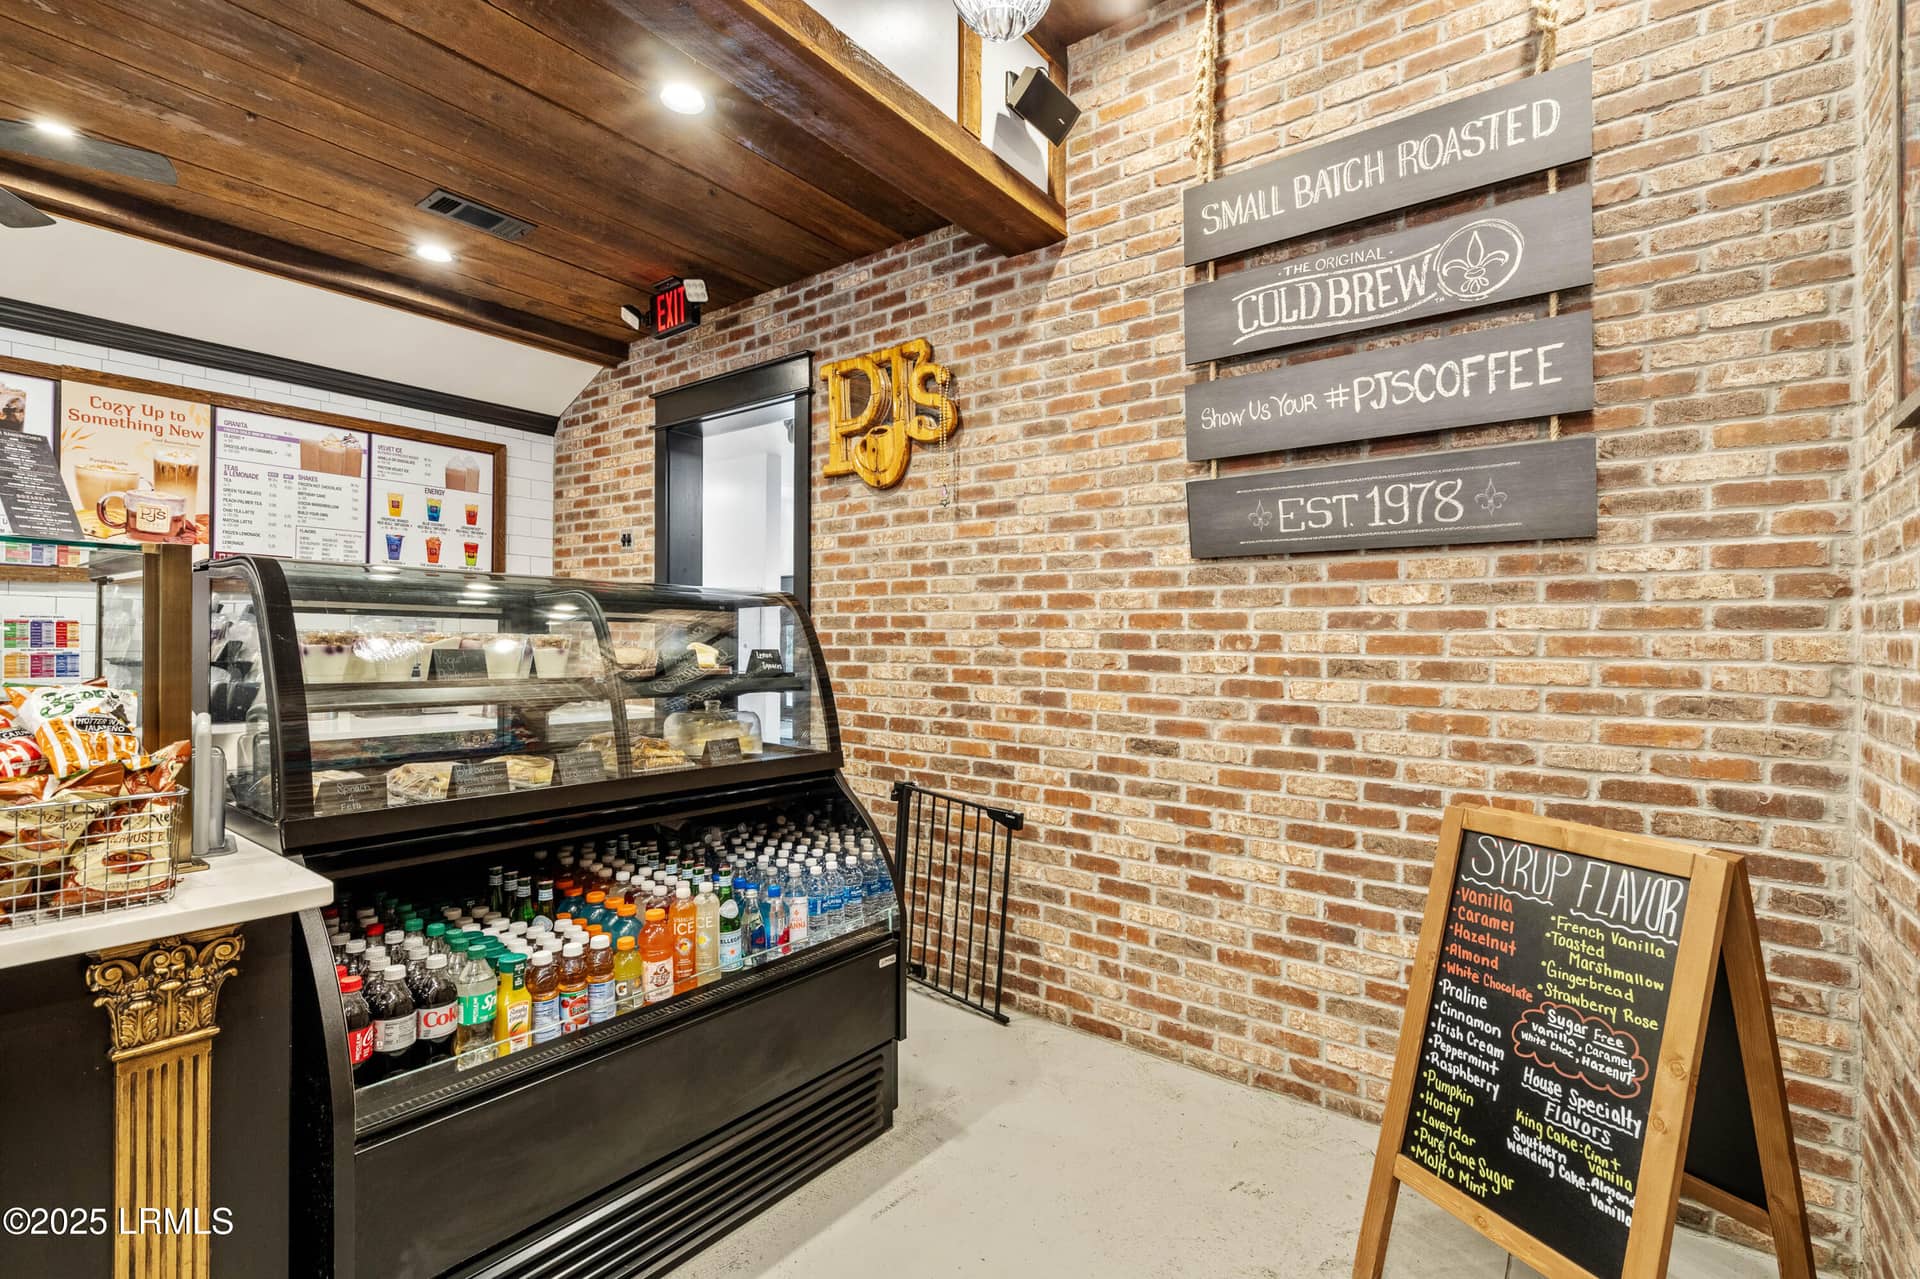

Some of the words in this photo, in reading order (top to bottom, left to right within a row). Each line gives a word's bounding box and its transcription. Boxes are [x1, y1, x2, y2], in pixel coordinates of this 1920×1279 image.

[1201, 184, 1285, 235] SMALL
[1294, 150, 1385, 209] BATCH
[1399, 98, 1561, 177] ROASTED
[1283, 261, 1311, 276] THE
[1315, 247, 1386, 271] ORIGINAL
[656, 285, 685, 332] EXIT
[1201, 407, 1245, 430] Show
[1249, 401, 1271, 420] Us
[1323, 342, 1565, 413] #PJSCOFFEE
[68, 408, 163, 437] Something
[169, 424, 204, 439] New
[141, 404, 164, 421] Up
[170, 410, 186, 422] to
[224, 463, 238, 471] TEAS
[229, 471, 259, 480] LEMONADE
[424, 487, 445, 496] ENERGY
[1367, 478, 1464, 527] 1978
[1471, 836, 1572, 900] SYRUP
[1577, 861, 1684, 937] FLAVOR
[673, 922, 695, 935] ICE
[1458, 906, 1515, 934] Caramel
[1557, 916, 1605, 942] French
[1611, 932, 1665, 958] Vanilla
[1450, 943, 1499, 970] Almond
[1454, 922, 1516, 957] Hazelnut
[1551, 931, 1605, 959] Toasted
[1447, 961, 1480, 983] White
[1483, 974, 1533, 1003] Chocolate
[1547, 960, 1634, 1003] Gingerbread
[1569, 952, 1664, 991] Marshmallow
[1442, 979, 1488, 1009] Praline
[1545, 982, 1617, 1024] Strawberry
[1623, 1008, 1659, 1030] Rose
[422, 1007, 459, 1028] Cok
[1440, 1000, 1501, 1038] Cinnamon
[1548, 1009, 1588, 1035] Sugar
[1594, 1028, 1624, 1048] Free
[1433, 1034, 1500, 1076] Peppermint
[1437, 1017, 1464, 1042] Irish
[1467, 1031, 1505, 1061] Cream
[1521, 1031, 1547, 1047] White
[1426, 1090, 1460, 1124] Honey
[1427, 1069, 1474, 1107] Pumpkin
[1523, 1066, 1563, 1098] House
[1569, 1088, 1642, 1139] Specialty
[1422, 1109, 1476, 1147] Lavendar
[1516, 1108, 1543, 1140] King
[1545, 1101, 1611, 1145] Flavors
[1420, 1127, 1446, 1154] Pure
[1449, 1142, 1476, 1170] Cane
[1479, 1157, 1515, 1195] Sugar
[1507, 1137, 1555, 1178] Wedding
[1512, 1125, 1567, 1164] Southern
[1459, 1169, 1488, 1198] Mint
